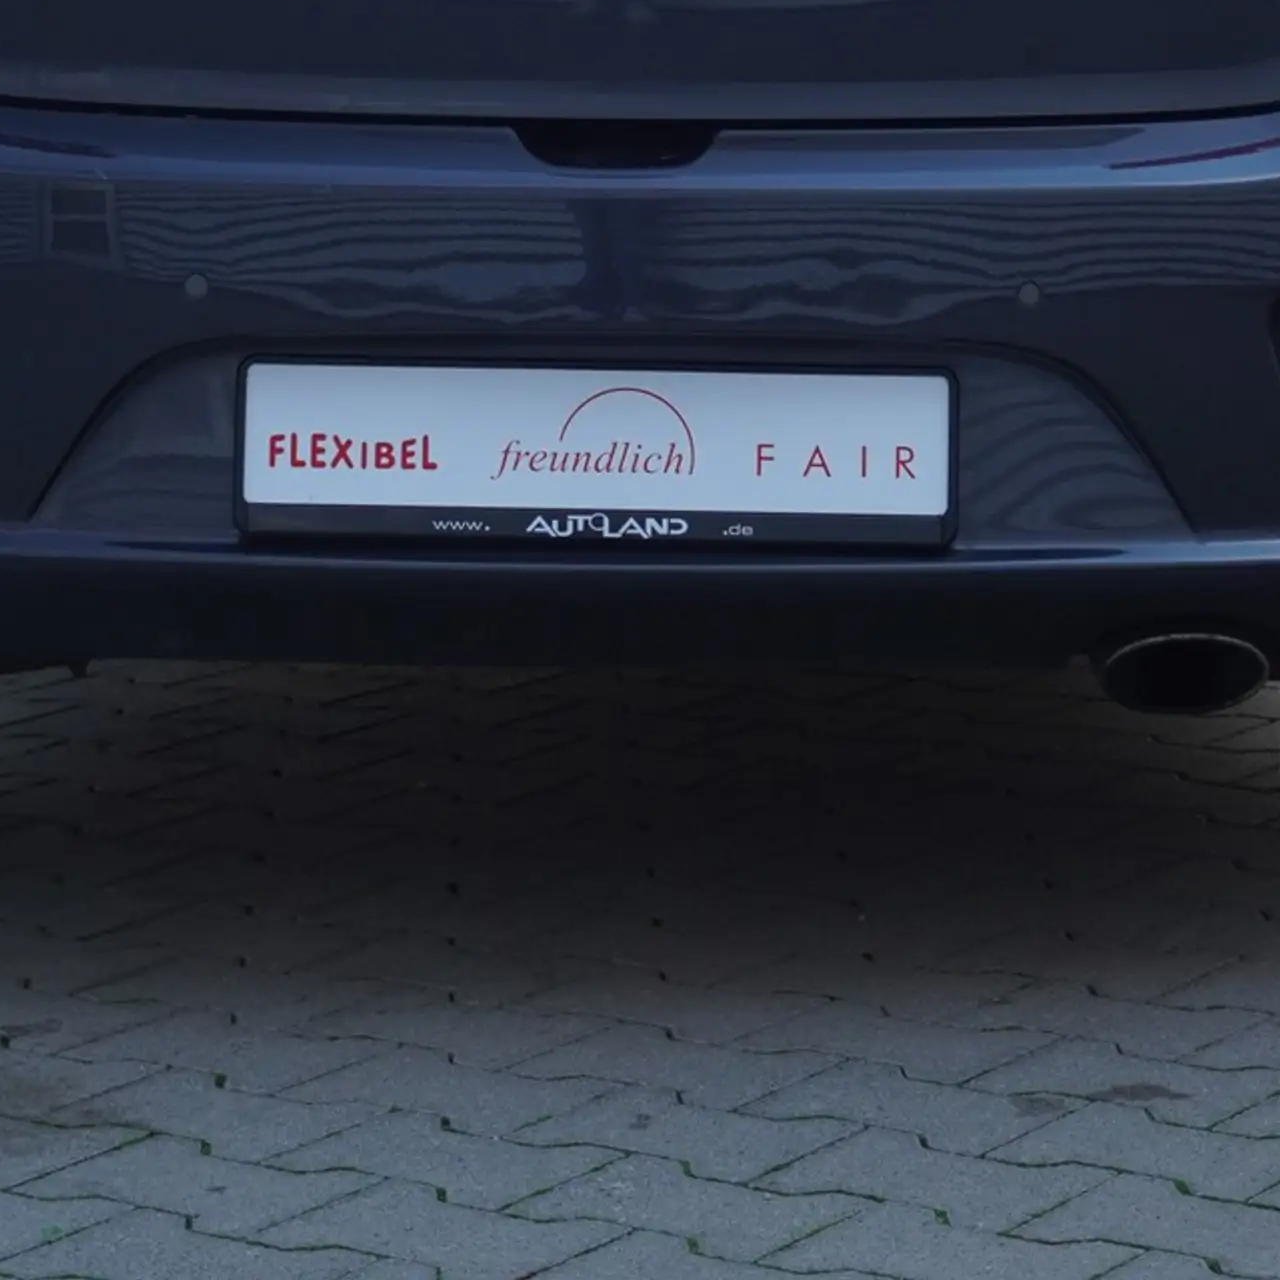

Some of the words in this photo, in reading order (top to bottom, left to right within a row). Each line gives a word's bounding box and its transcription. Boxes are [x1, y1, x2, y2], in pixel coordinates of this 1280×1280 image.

[268, 432, 438, 471] FLEXIBEL
[490, 439, 684, 480] freundlich
[755, 443, 916, 480] FAIR
[526, 513, 689, 539] AUTOLAND
